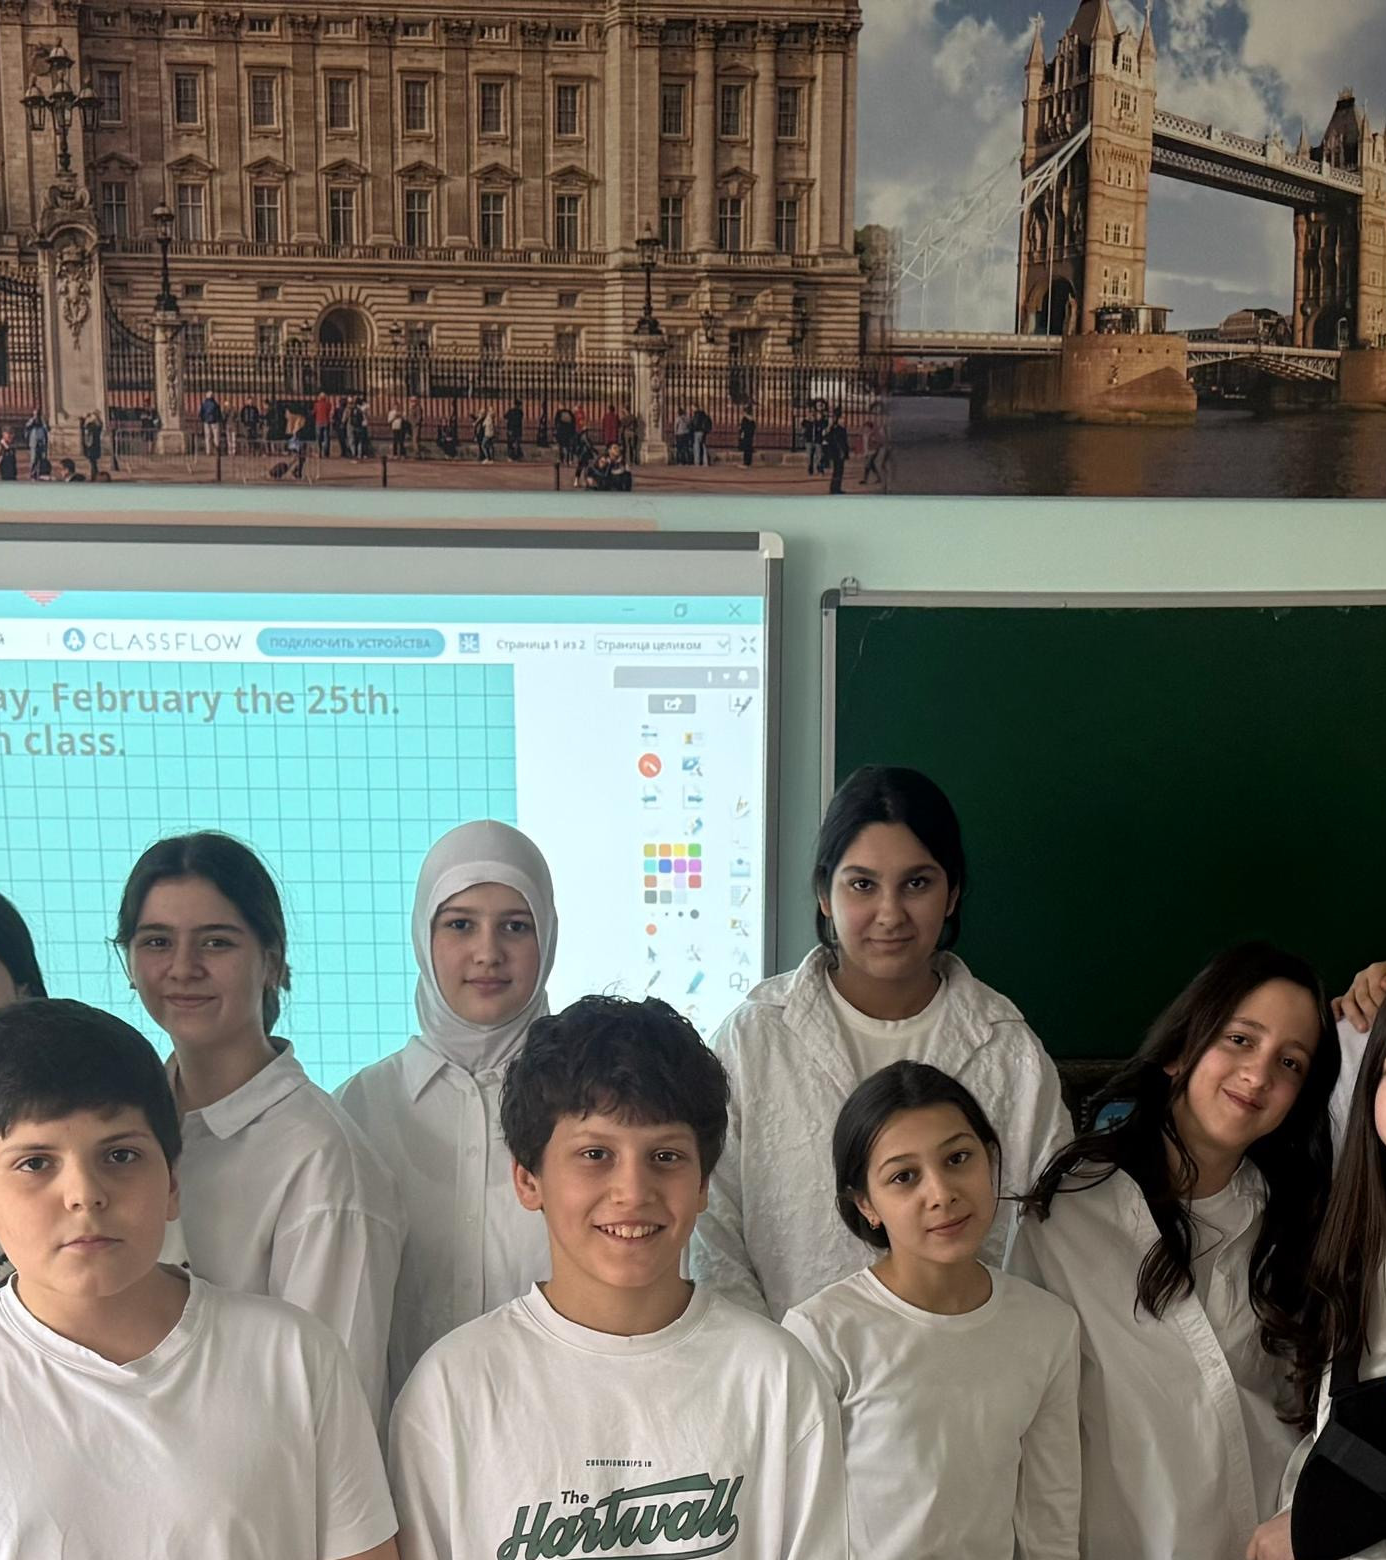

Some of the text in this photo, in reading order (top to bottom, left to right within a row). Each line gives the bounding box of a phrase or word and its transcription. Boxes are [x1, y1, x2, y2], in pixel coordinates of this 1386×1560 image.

[92, 632, 243, 653] CLASSFLOW
[269, 636, 432, 651] ПОДКЛЮЧИТЬ УСТРОЙСТВА
[497, 638, 551, 652] Страница
[563, 640, 577, 650] из
[597, 639, 702, 653] Страница целиком
[52, 682, 222, 723] February
[234, 683, 295, 714] the
[307, 684, 401, 715] 25th.
[24, 725, 127, 757] class.
[561, 1490, 589, 1504] The
